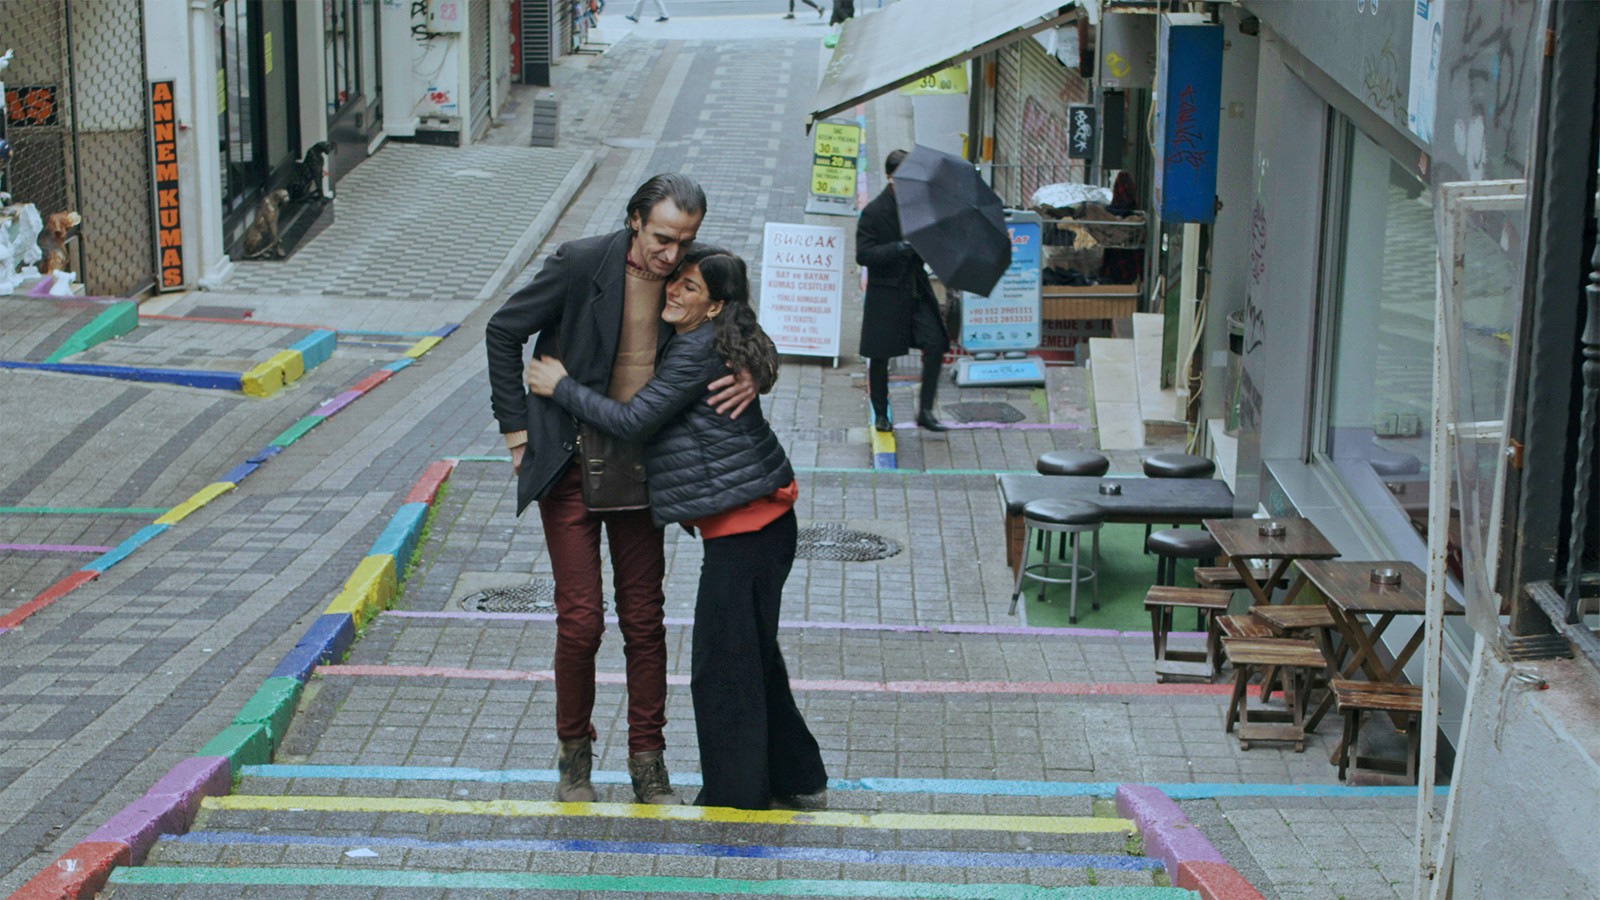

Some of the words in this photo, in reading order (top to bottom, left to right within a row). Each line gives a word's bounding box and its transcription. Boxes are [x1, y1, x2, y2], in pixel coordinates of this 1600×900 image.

[152, 82, 178, 182] ANNEM
[819, 142, 832, 154] 30
[831, 155, 845, 168] 20
[815, 181, 829, 193] 30
[775, 270, 791, 280] BAY
[803, 271, 830, 282] BAYAN
[985, 307, 999, 315] 552
